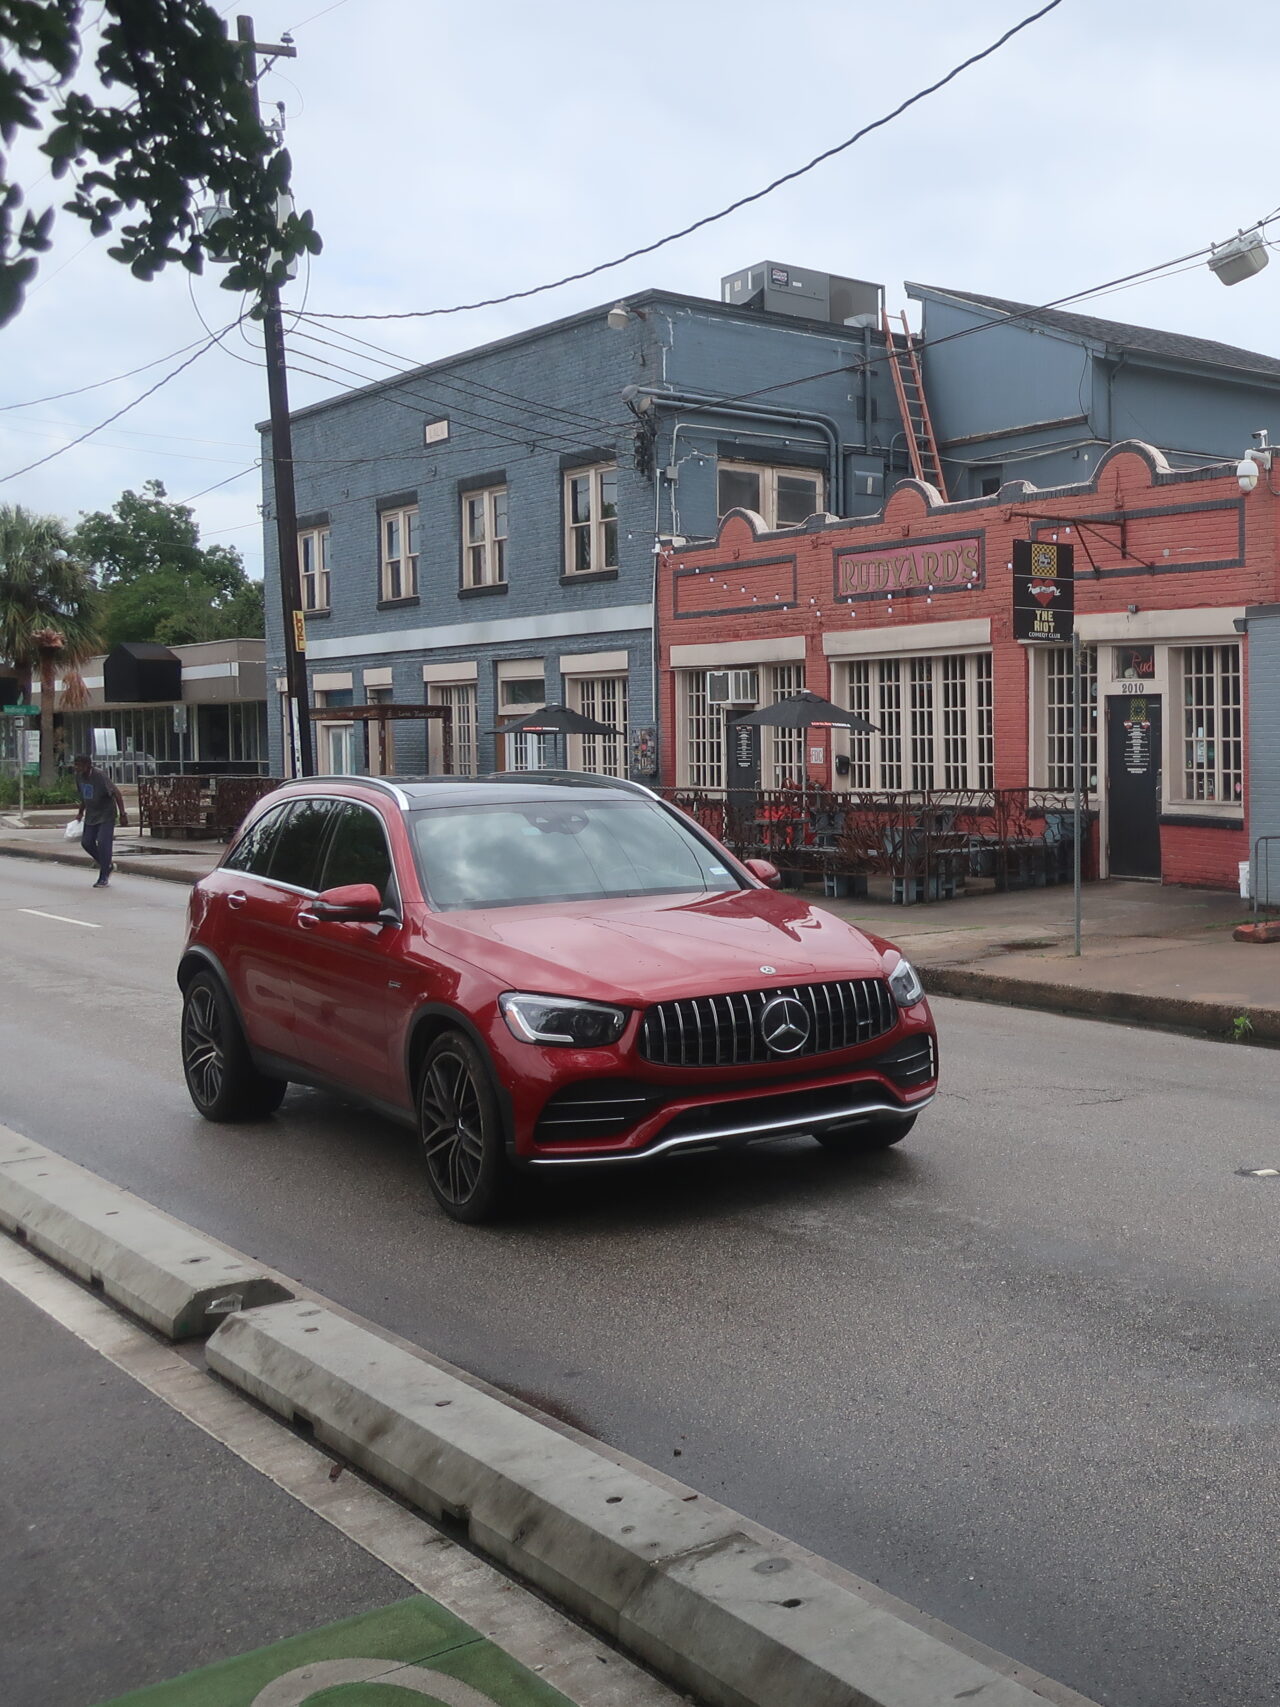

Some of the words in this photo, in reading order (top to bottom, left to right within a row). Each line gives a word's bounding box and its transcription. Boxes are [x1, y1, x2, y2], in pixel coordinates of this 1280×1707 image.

[841, 545, 978, 592] RUDYARD'S
[1036, 610, 1054, 621] THE
[1034, 621, 1055, 632] RIOT
[1122, 683, 1144, 694] 2010
